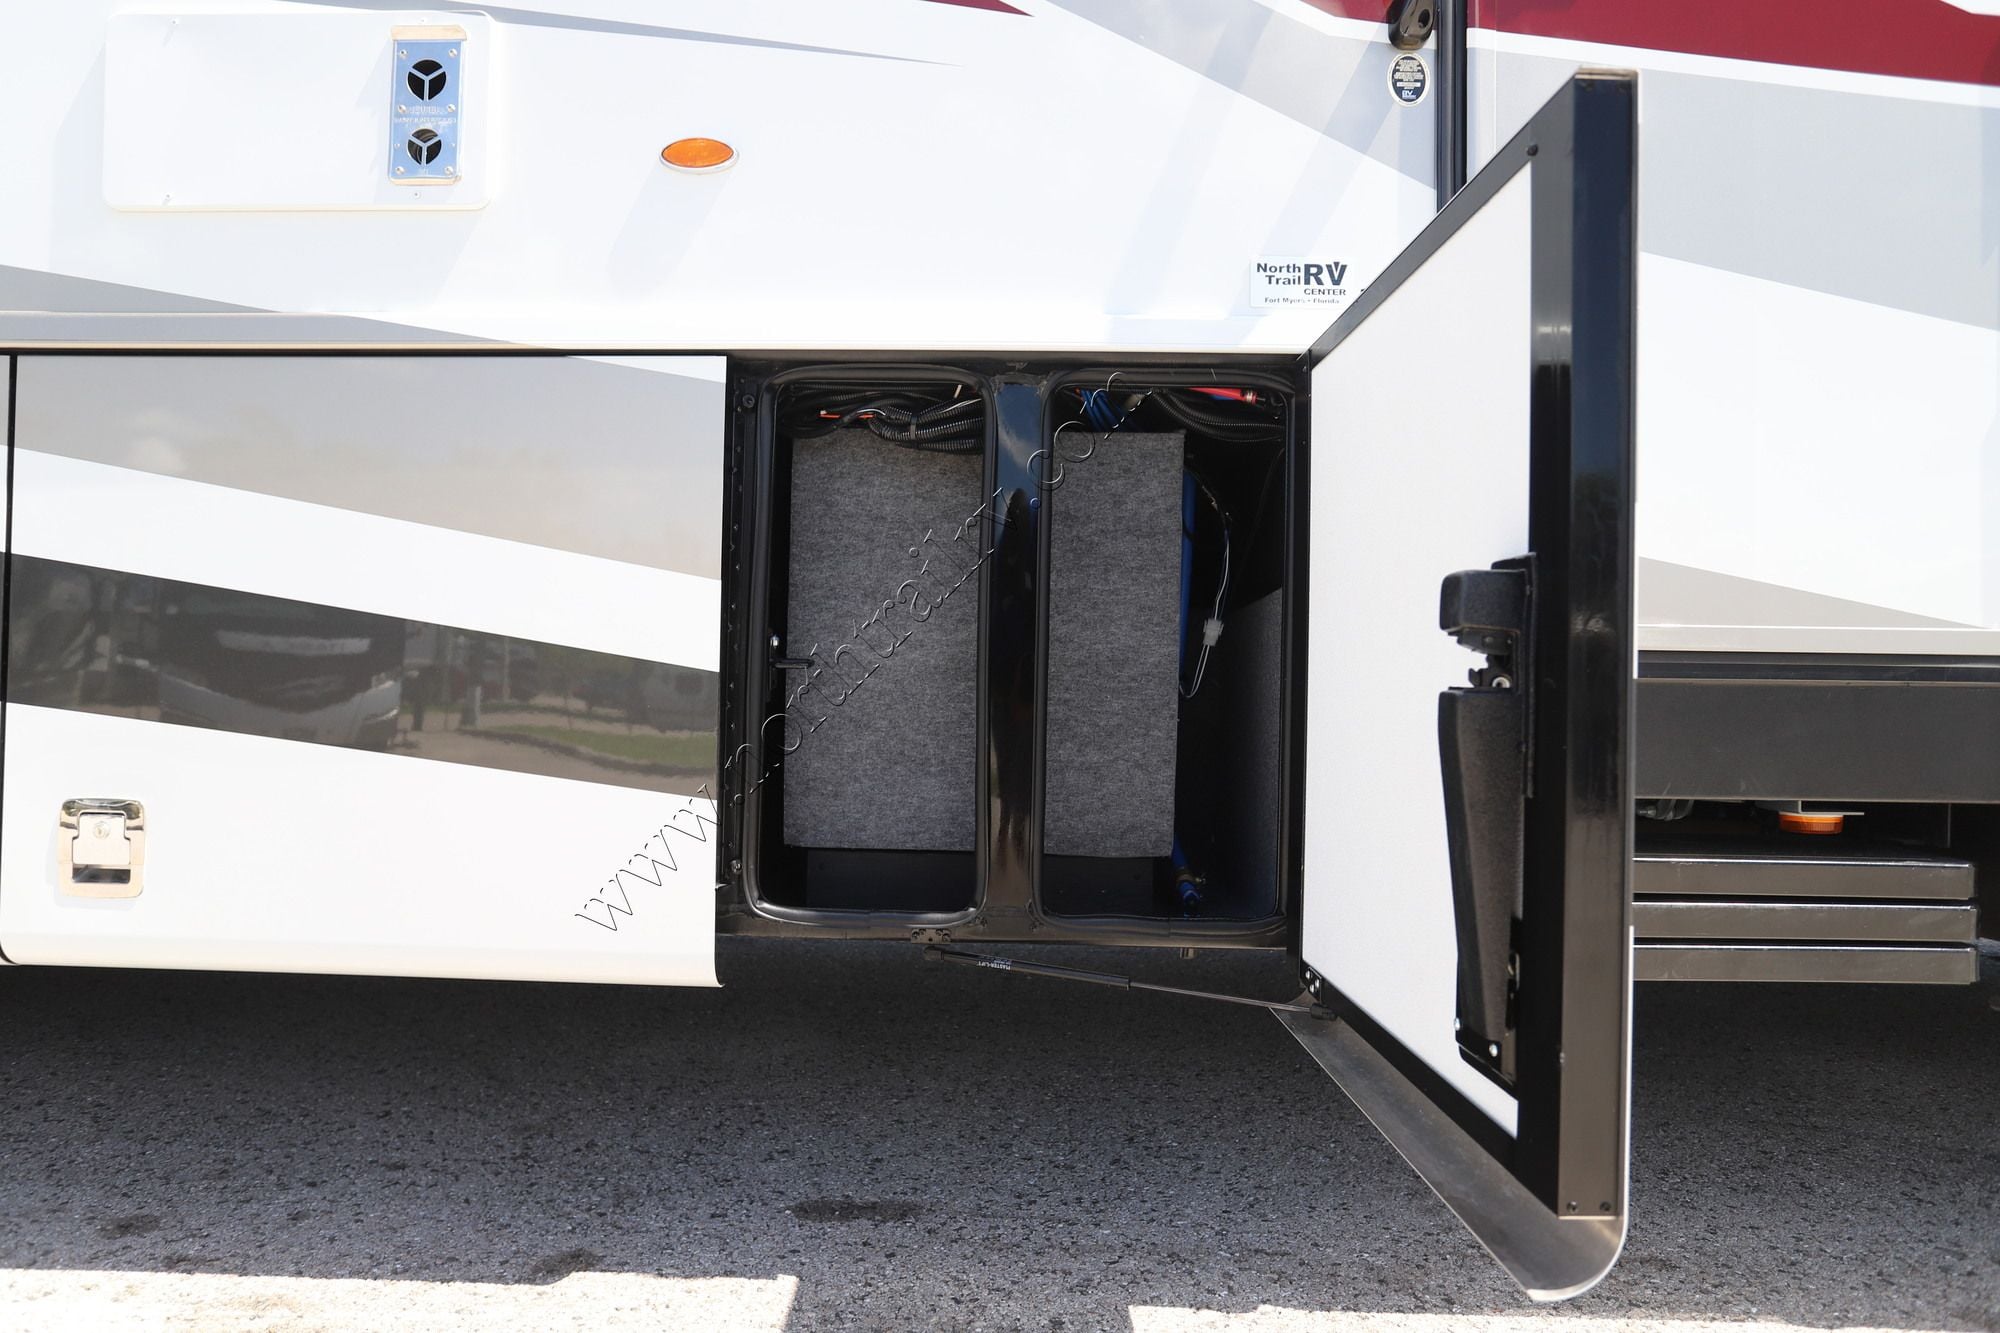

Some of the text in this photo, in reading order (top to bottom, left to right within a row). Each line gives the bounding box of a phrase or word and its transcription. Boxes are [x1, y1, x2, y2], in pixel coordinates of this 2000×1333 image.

[1256, 262, 1301, 273] North
[1303, 261, 1348, 286] RV
[1265, 274, 1301, 285] Trail
[1303, 288, 1346, 296] CENTER
